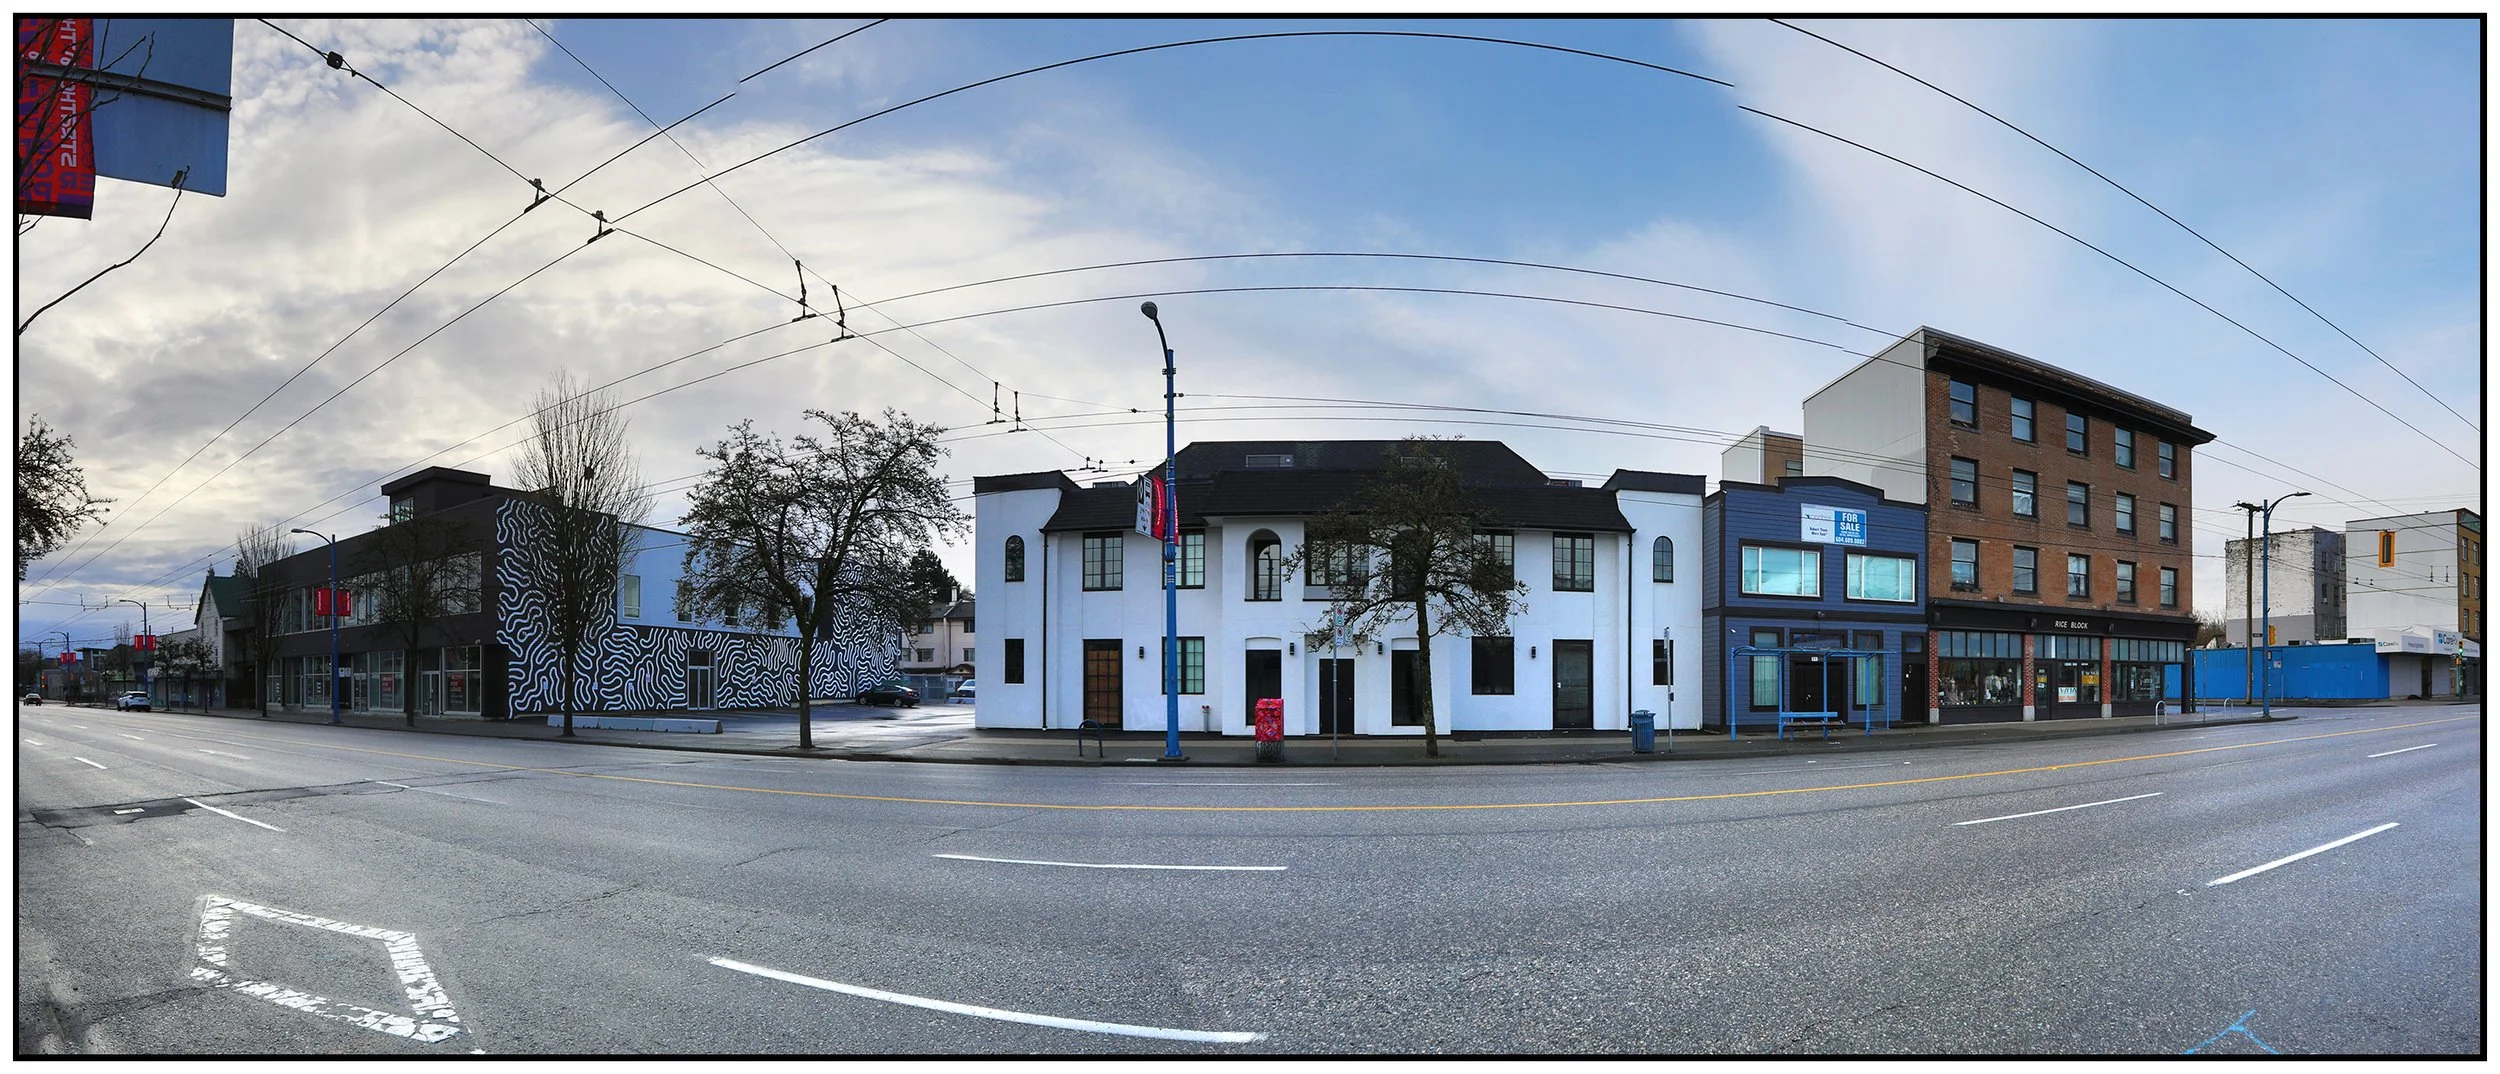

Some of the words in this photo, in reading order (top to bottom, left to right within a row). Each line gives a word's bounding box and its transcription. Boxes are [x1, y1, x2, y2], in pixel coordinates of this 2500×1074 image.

[1842, 512, 1858, 523] FOR
[1840, 521, 1861, 532] SALE
[2055, 620, 2068, 628] RICE
[2070, 621, 2089, 629] BLOCK
